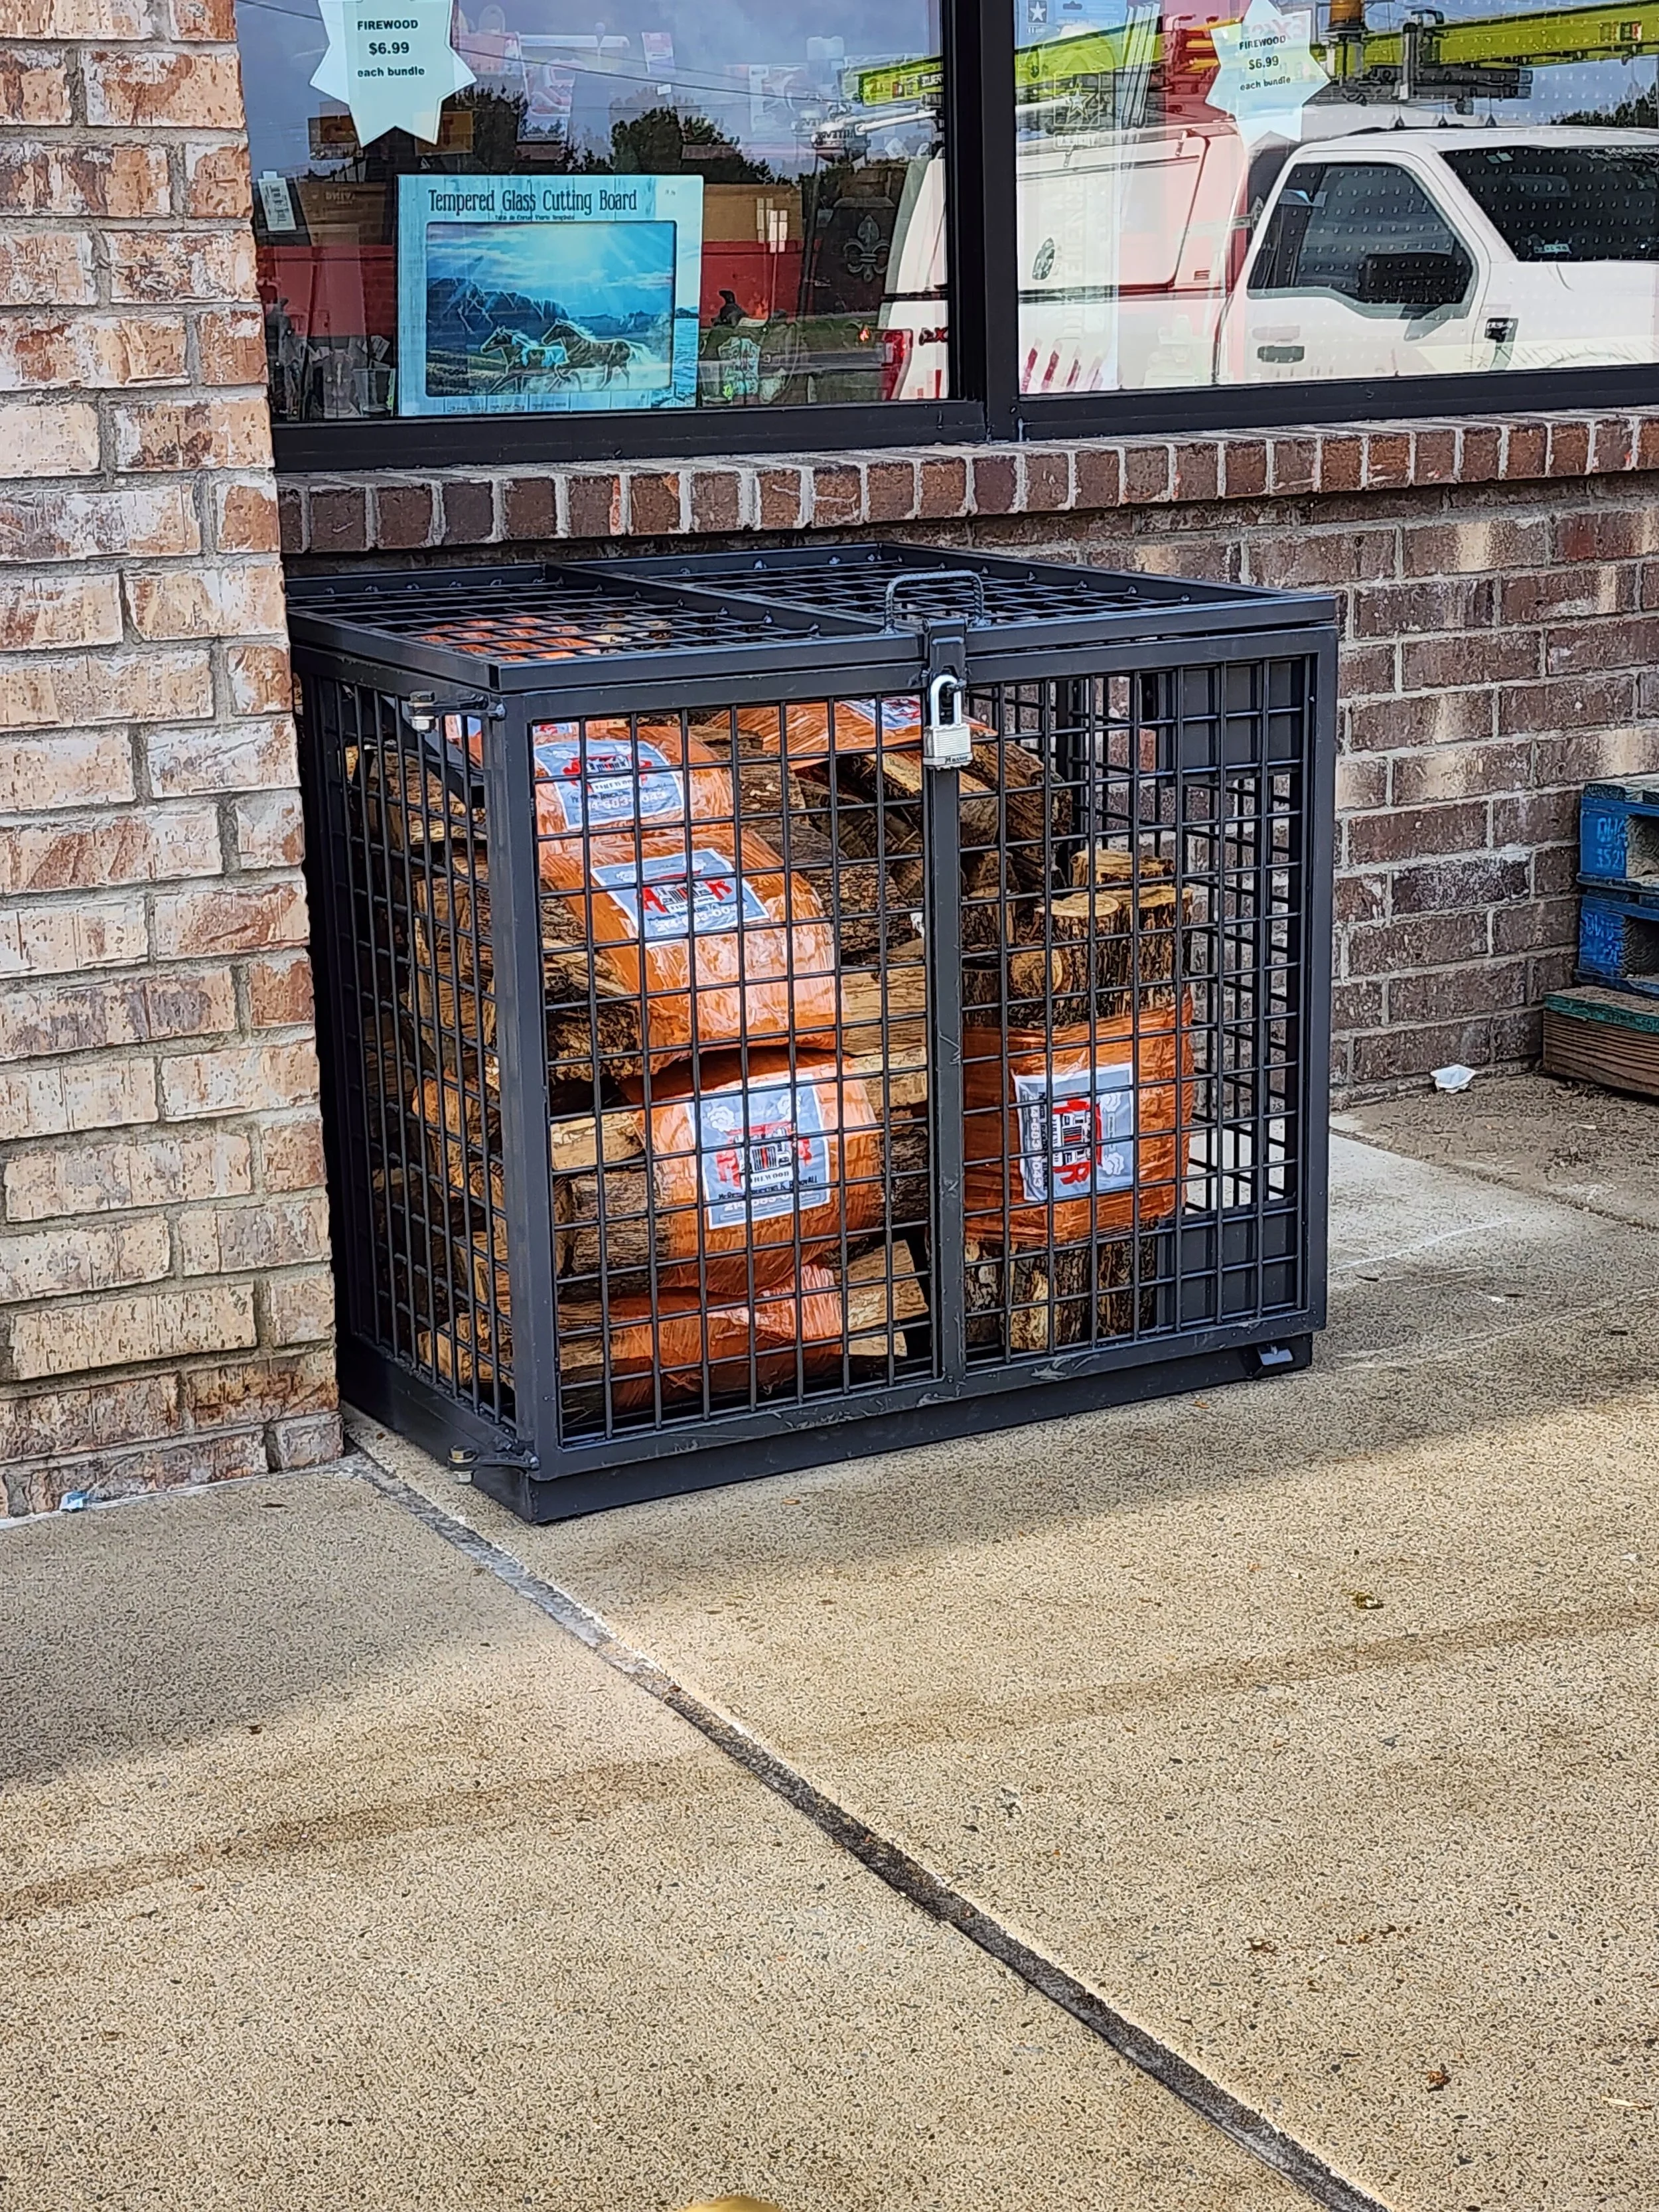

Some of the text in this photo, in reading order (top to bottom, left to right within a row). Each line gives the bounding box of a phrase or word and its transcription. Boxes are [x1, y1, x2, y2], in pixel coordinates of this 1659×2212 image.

[357, 19, 419, 31] FIREWOOD
[368, 41, 409, 56] $6.99
[1238, 35, 1286, 50] FIREWOOD
[1248, 55, 1279, 70] $6.99
[357, 66, 425, 78] each bundle
[1240, 76, 1291, 91] each bundle
[427, 189, 637, 216] Tempered Glass Cutting Board
